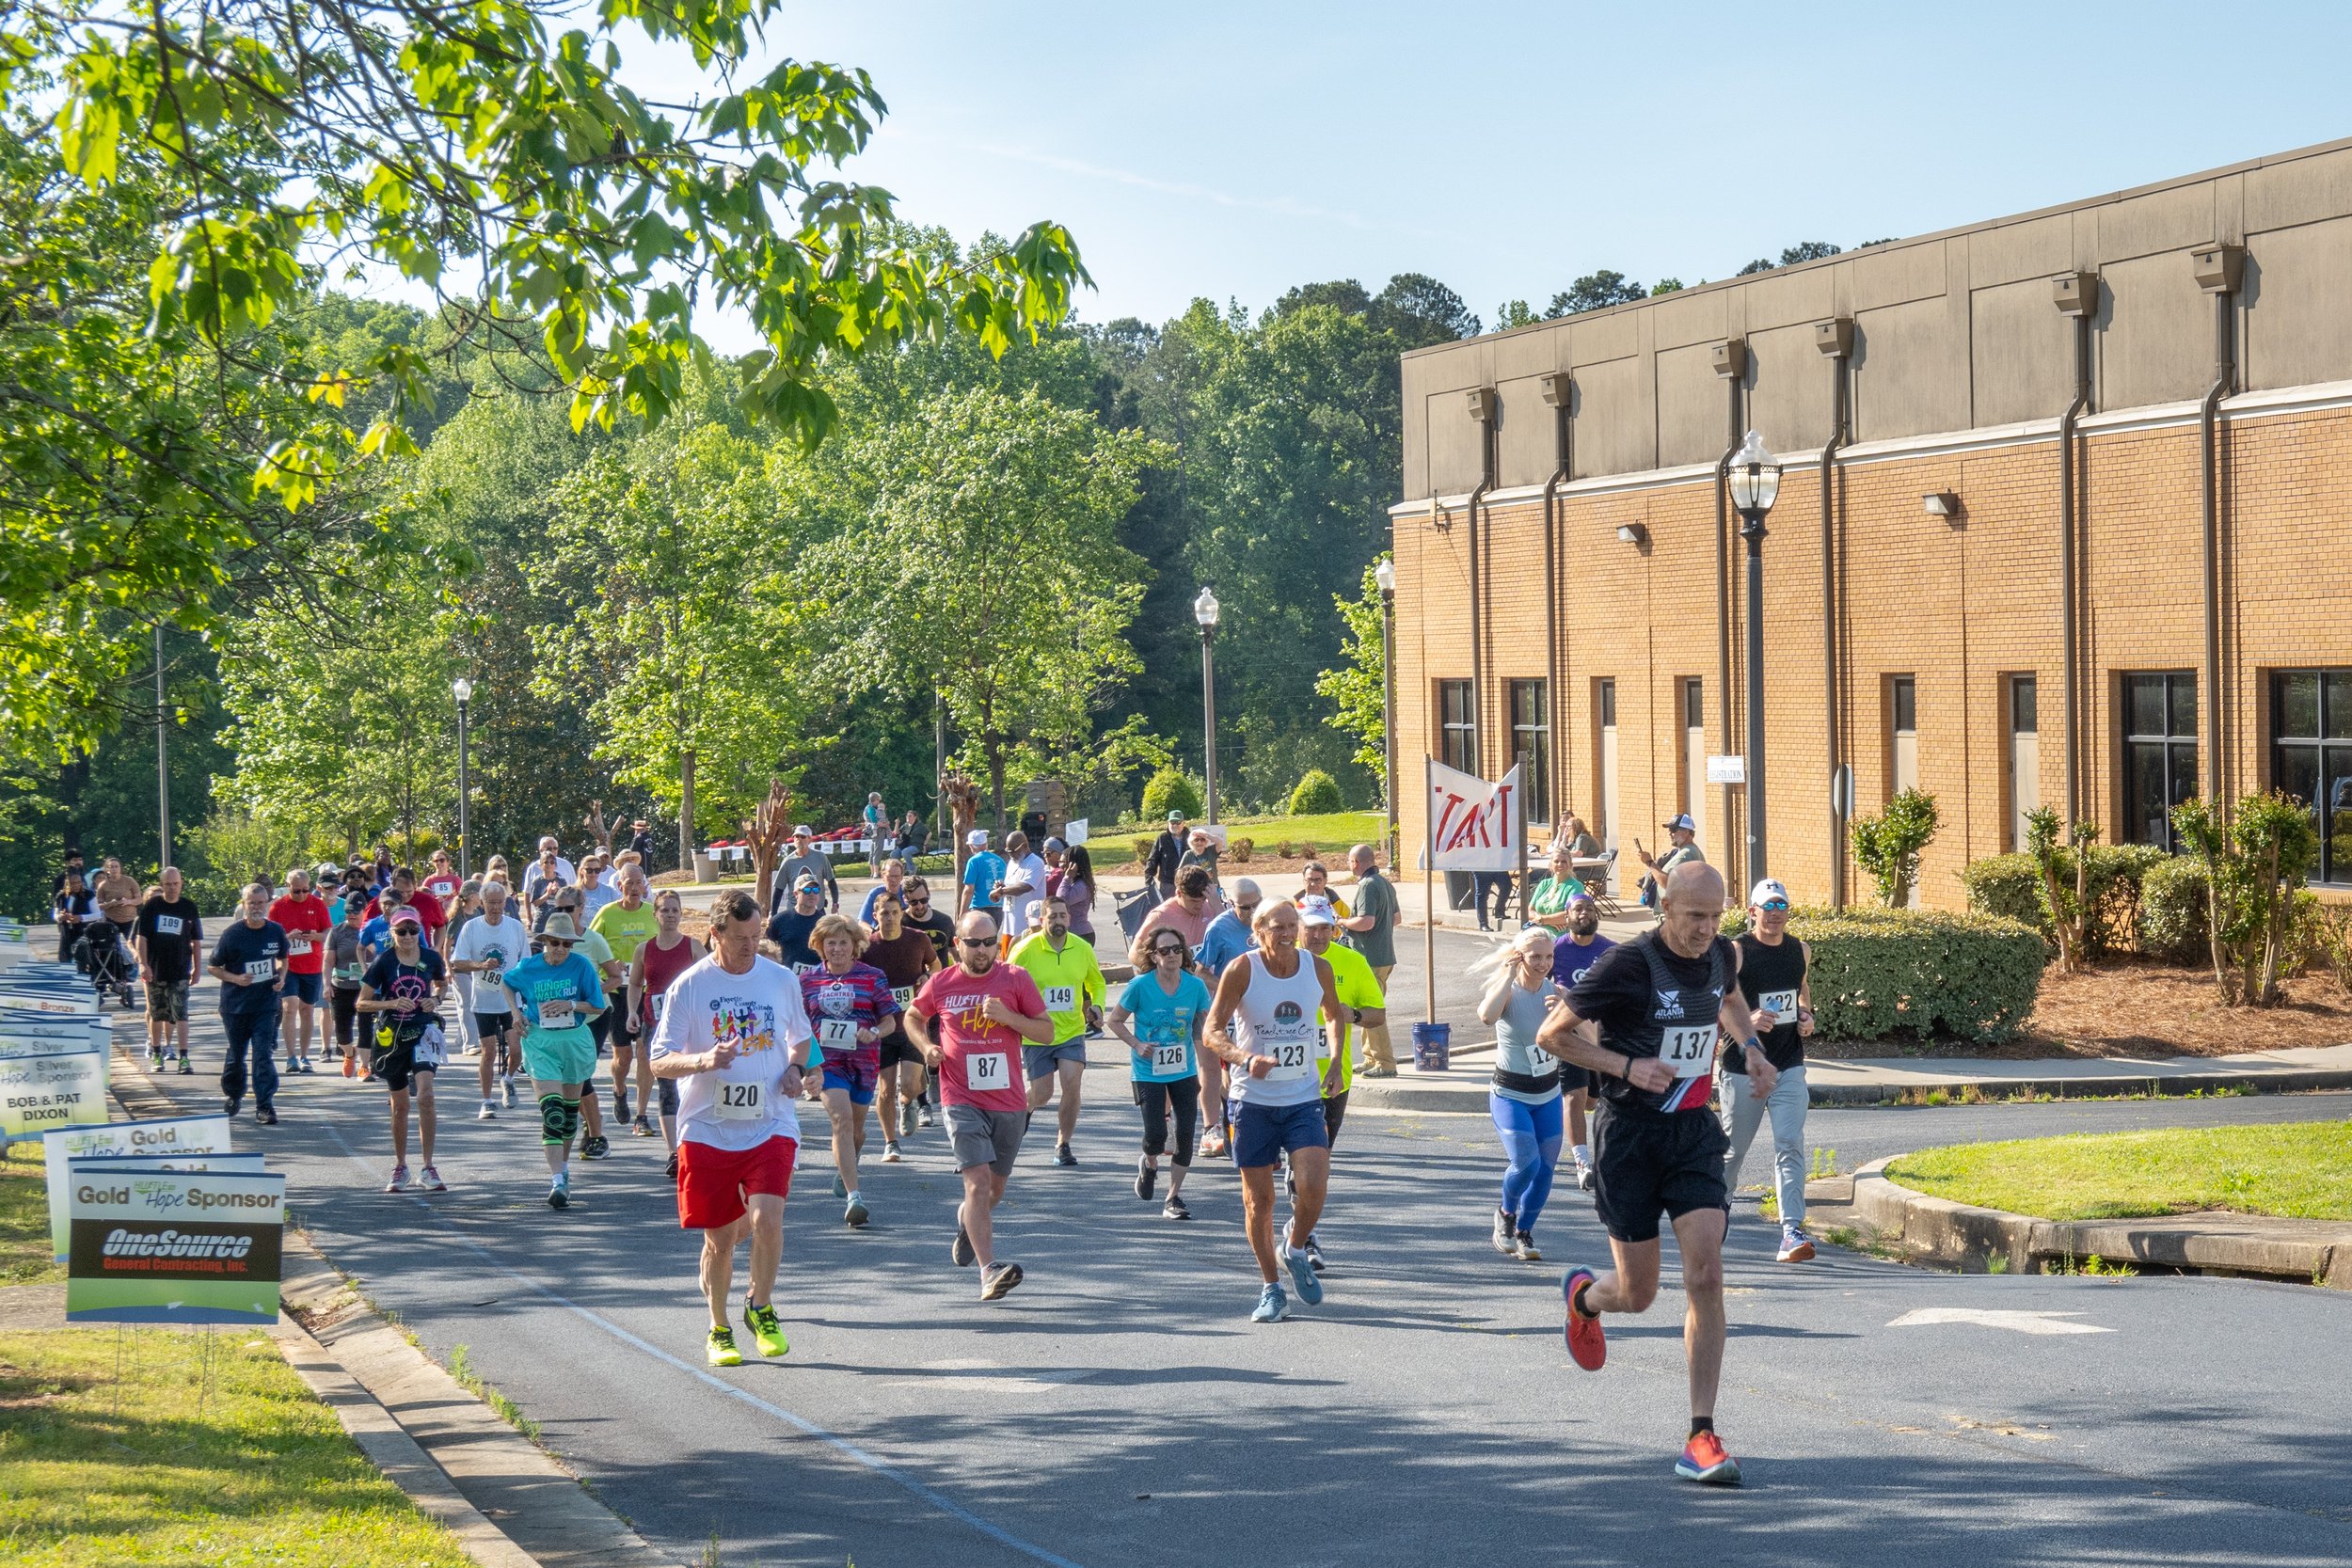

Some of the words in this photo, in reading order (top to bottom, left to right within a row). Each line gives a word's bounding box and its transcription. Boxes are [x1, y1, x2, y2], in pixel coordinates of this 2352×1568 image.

[162, 917, 180, 928] 109
[250, 961, 270, 975] 112
[482, 970, 501, 985] 189
[534, 978, 572, 993] HUNGER
[536, 989, 562, 1002] WALK
[895, 989, 910, 1004] 99
[1050, 988, 1071, 1003] 149
[1766, 993, 1792, 1012] 22
[40, 1002, 76, 1013] Bronze
[1655, 1007, 1684, 1017] ATLANTA
[830, 1022, 847, 1039] 77
[32, 1041, 65, 1053] Silver
[1671, 1030, 1711, 1060] 137
[1158, 1047, 1183, 1066] 126
[1273, 1045, 1305, 1068] 123
[36, 1061, 73, 1071] Silver
[977, 1057, 997, 1078] 87
[38, 1071, 93, 1085] Sponsor
[8, 1096, 38, 1108] BOB
[42, 1096, 51, 1105] &
[56, 1093, 81, 1105] PAT
[723, 1085, 758, 1107] 120
[24, 1108, 69, 1121] DIXON
[131, 1128, 176, 1147] Gold
[77, 1185, 130, 1205] Gold
[187, 1188, 280, 1210] Sponsor
[146, 1189, 184, 1213] Hope
[103, 1228, 253, 1259] OneSource
[103, 1258, 151, 1271] General
